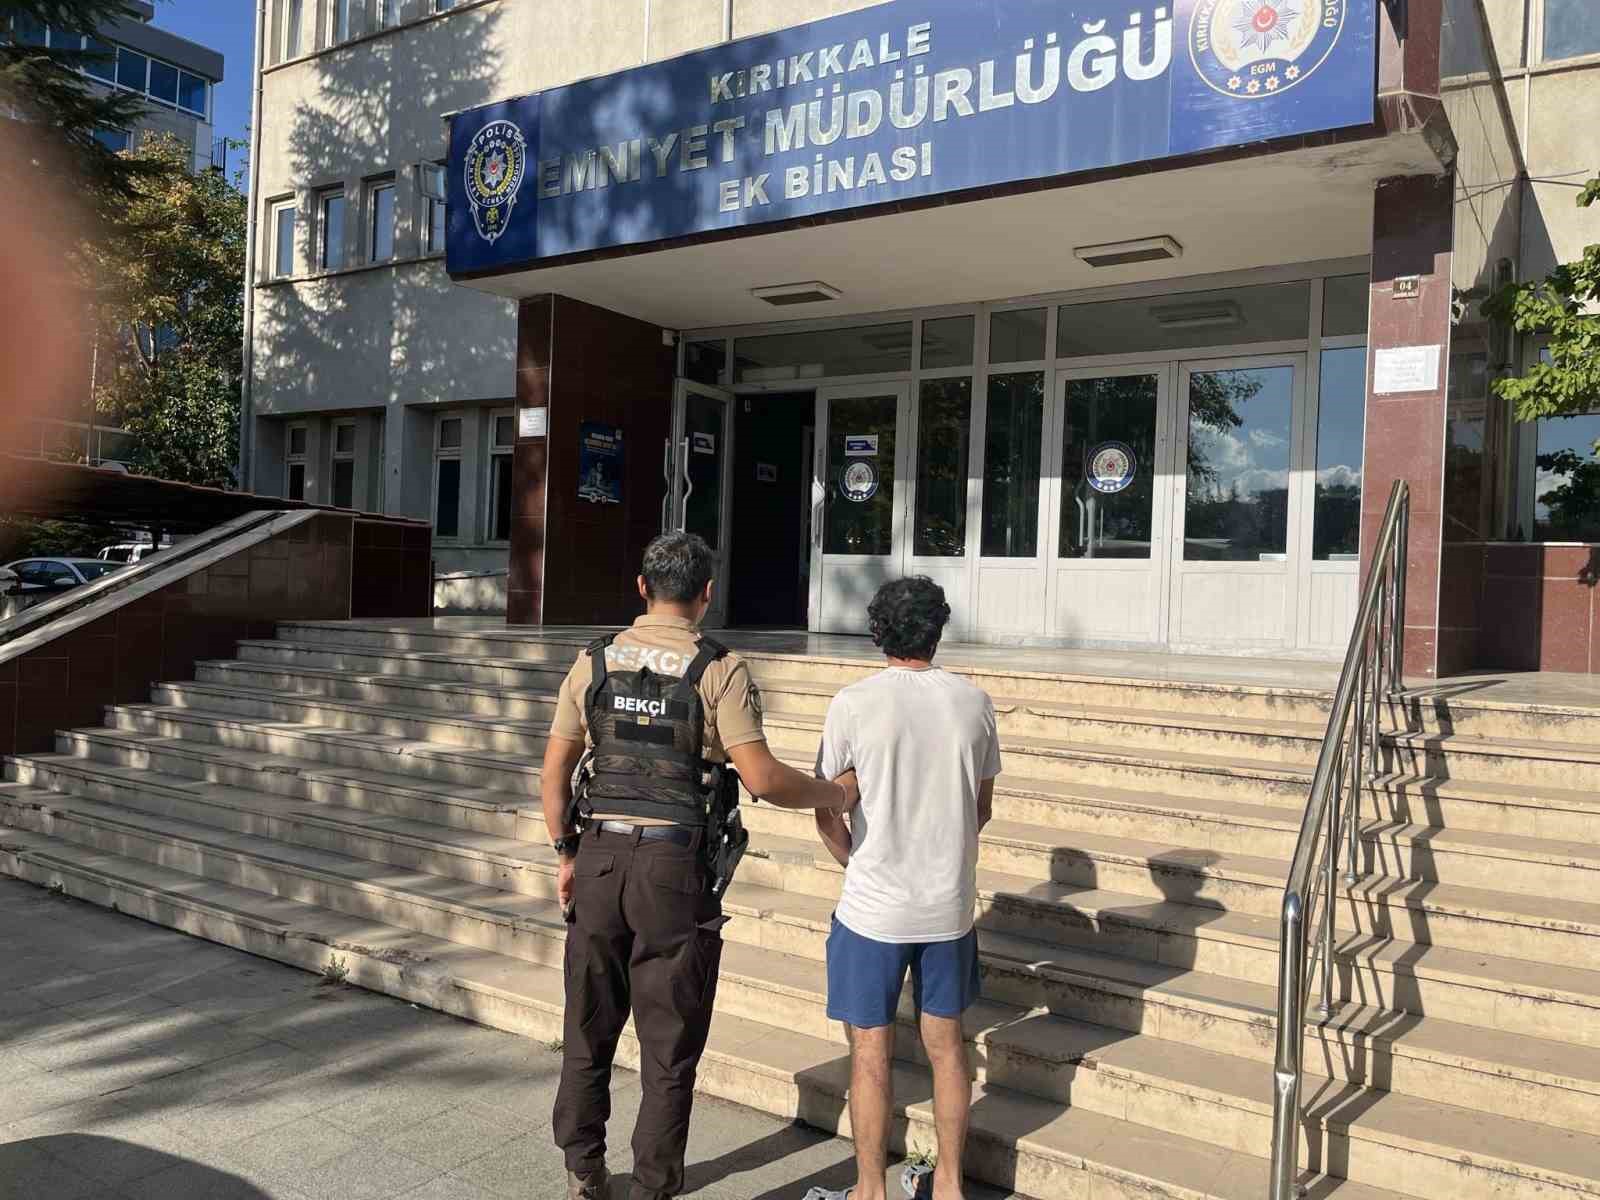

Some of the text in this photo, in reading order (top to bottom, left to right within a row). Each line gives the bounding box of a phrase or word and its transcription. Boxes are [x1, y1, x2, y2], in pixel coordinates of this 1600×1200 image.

[1250, 62, 1276, 76] EGM
[764, 7, 1172, 155] MÜDÜRLÜĞÜ
[479, 125, 513, 144] POLİS
[719, 142, 932, 213] EK BİNASI
[1399, 281, 1412, 290] 04
[614, 695, 666, 717] BEKÇİ
